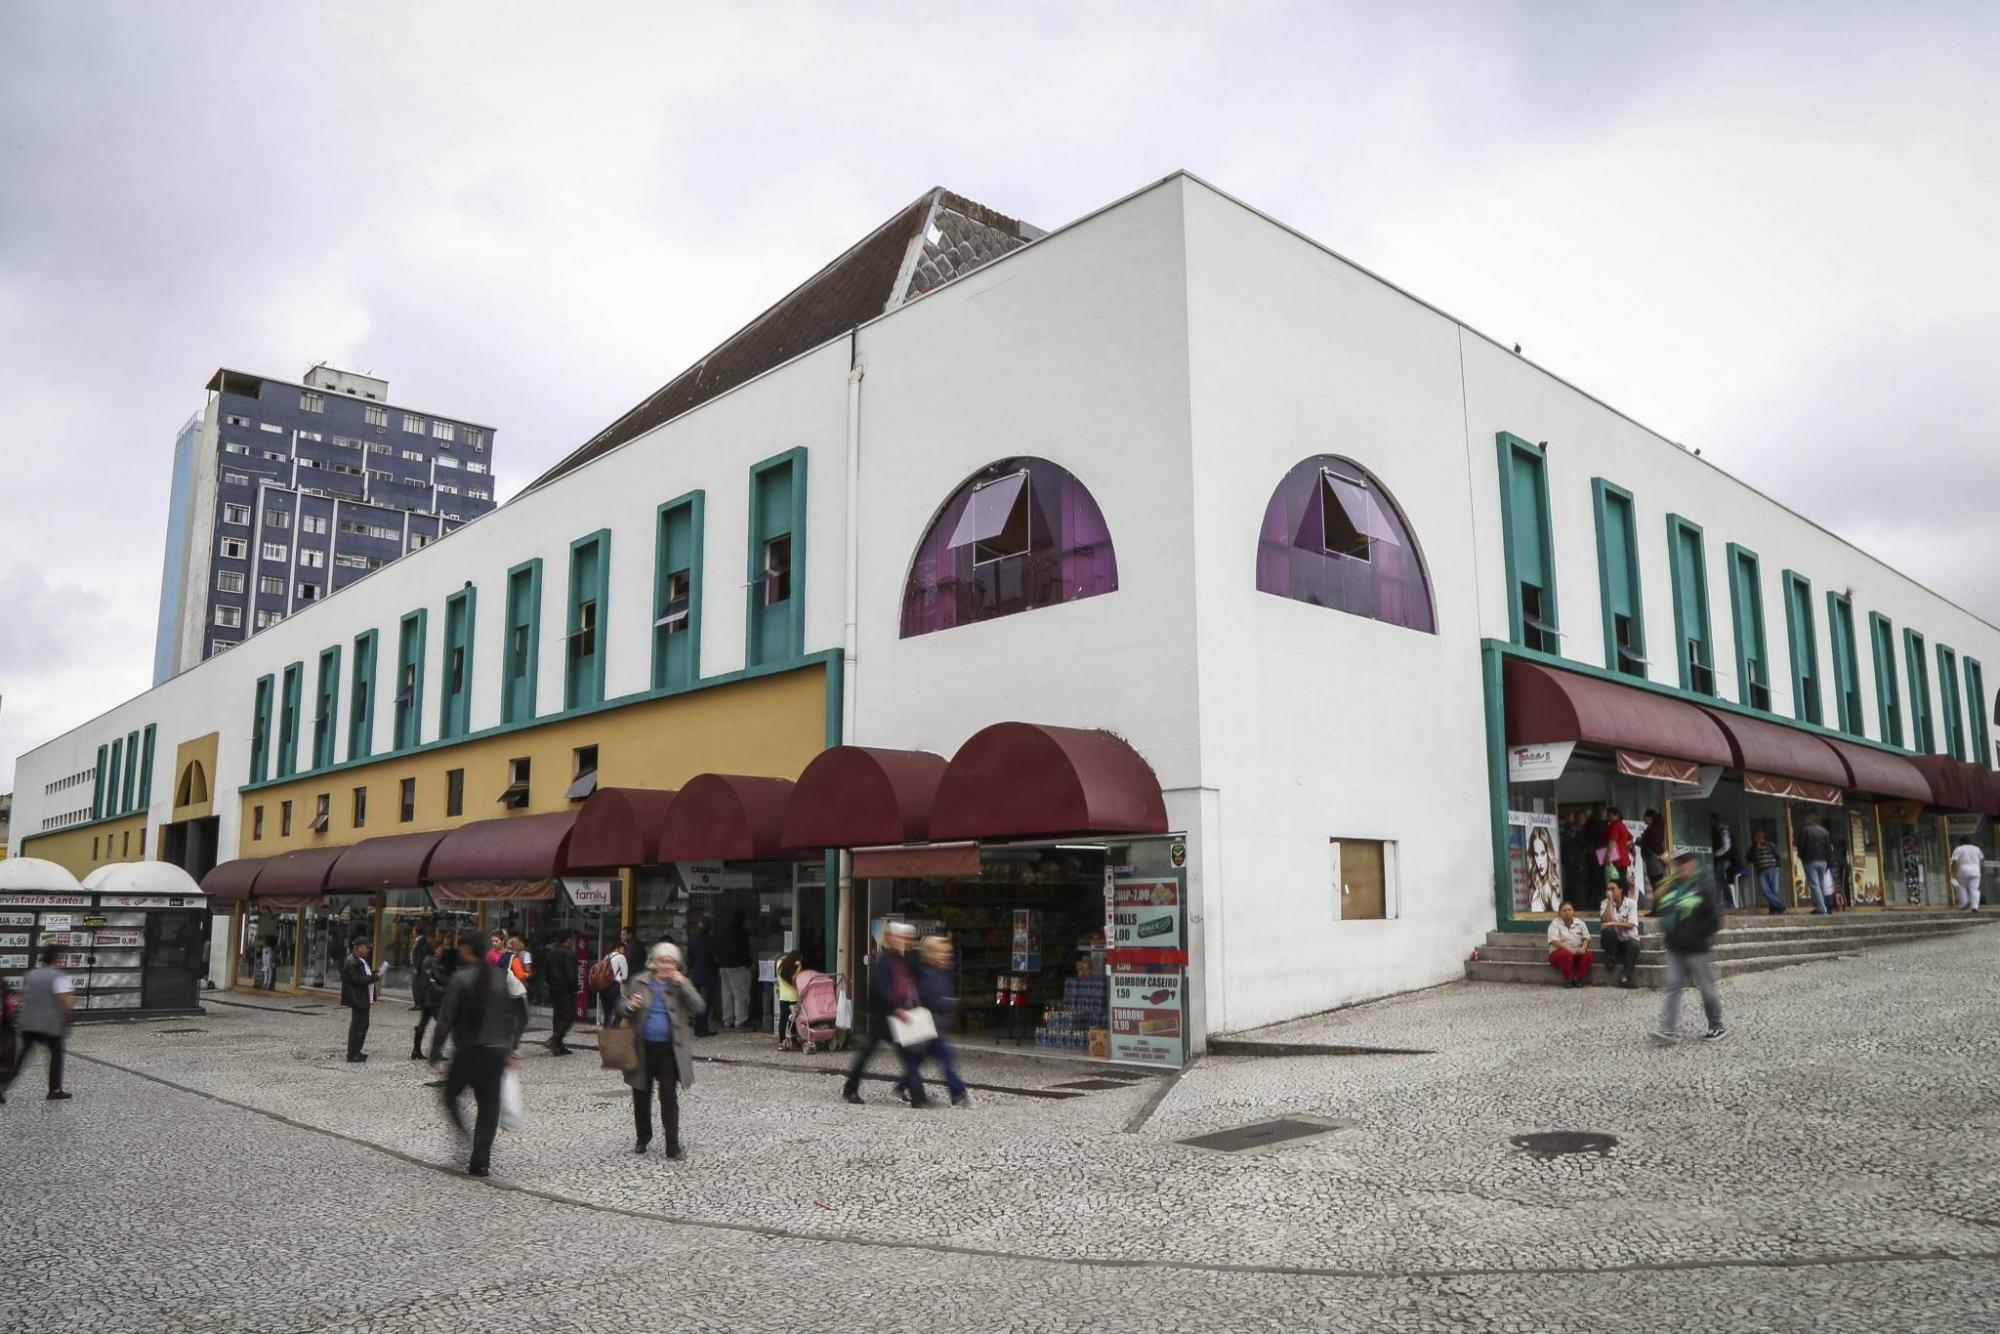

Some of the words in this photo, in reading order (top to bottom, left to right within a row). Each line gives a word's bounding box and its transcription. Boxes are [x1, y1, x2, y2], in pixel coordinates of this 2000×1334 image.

[48, 895, 84, 904] Santos
[575, 888, 606, 902] family
[1114, 913, 1137, 926] HALLS
[1115, 976, 1146, 987] BOMBOM
[1147, 977, 1178, 988] CASEIRO
[1114, 1009, 1145, 1020] TORRONE
